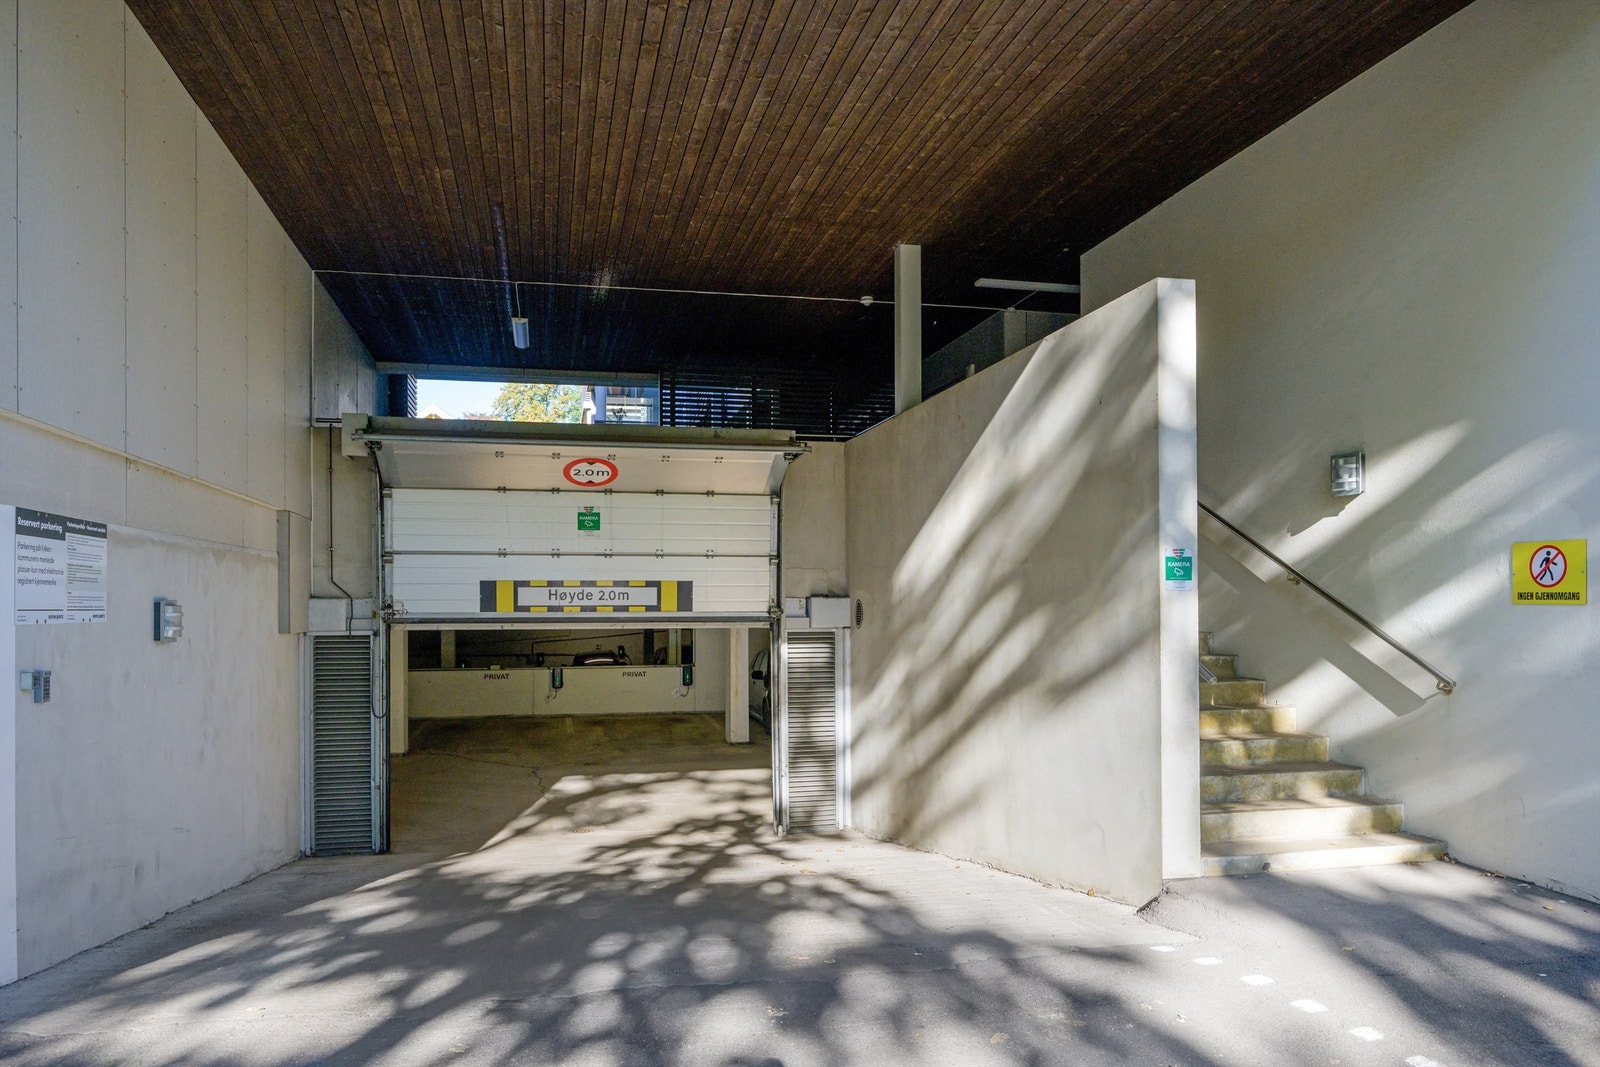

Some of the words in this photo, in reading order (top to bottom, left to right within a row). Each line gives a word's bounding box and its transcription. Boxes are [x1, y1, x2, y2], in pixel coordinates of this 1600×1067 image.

[17, 516, 40, 528] Reservert
[40, 522, 63, 534] parkering
[17, 541, 35, 552] Parkering
[35, 544, 41, 552] på
[39, 556, 55, 564] merkede
[38, 567, 46, 575] med
[548, 589, 593, 604] Høyde
[1517, 592, 1534, 600] INGEN
[1535, 592, 1580, 600] GJENNOMGANG
